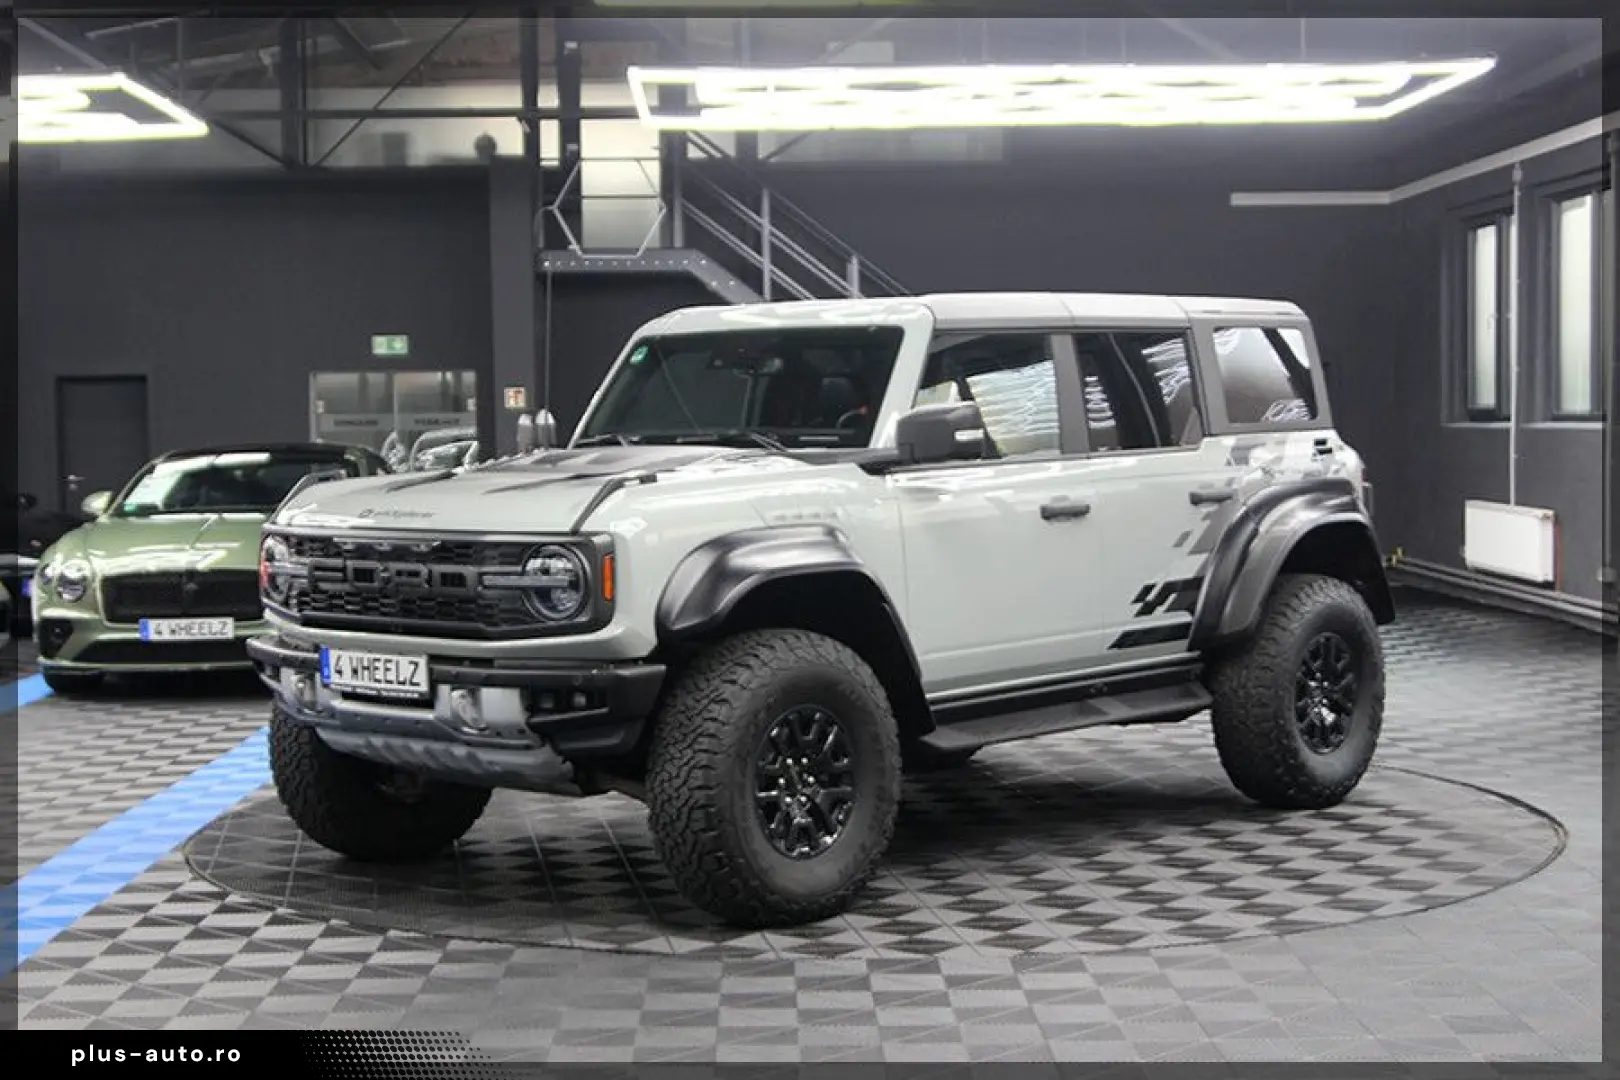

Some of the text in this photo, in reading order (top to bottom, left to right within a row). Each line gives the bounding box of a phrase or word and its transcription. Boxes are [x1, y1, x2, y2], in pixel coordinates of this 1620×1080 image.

[308, 558, 479, 597] FORD
[154, 620, 229, 637] 4 WHEELZ
[334, 654, 421, 687] 4 WHEELZ
